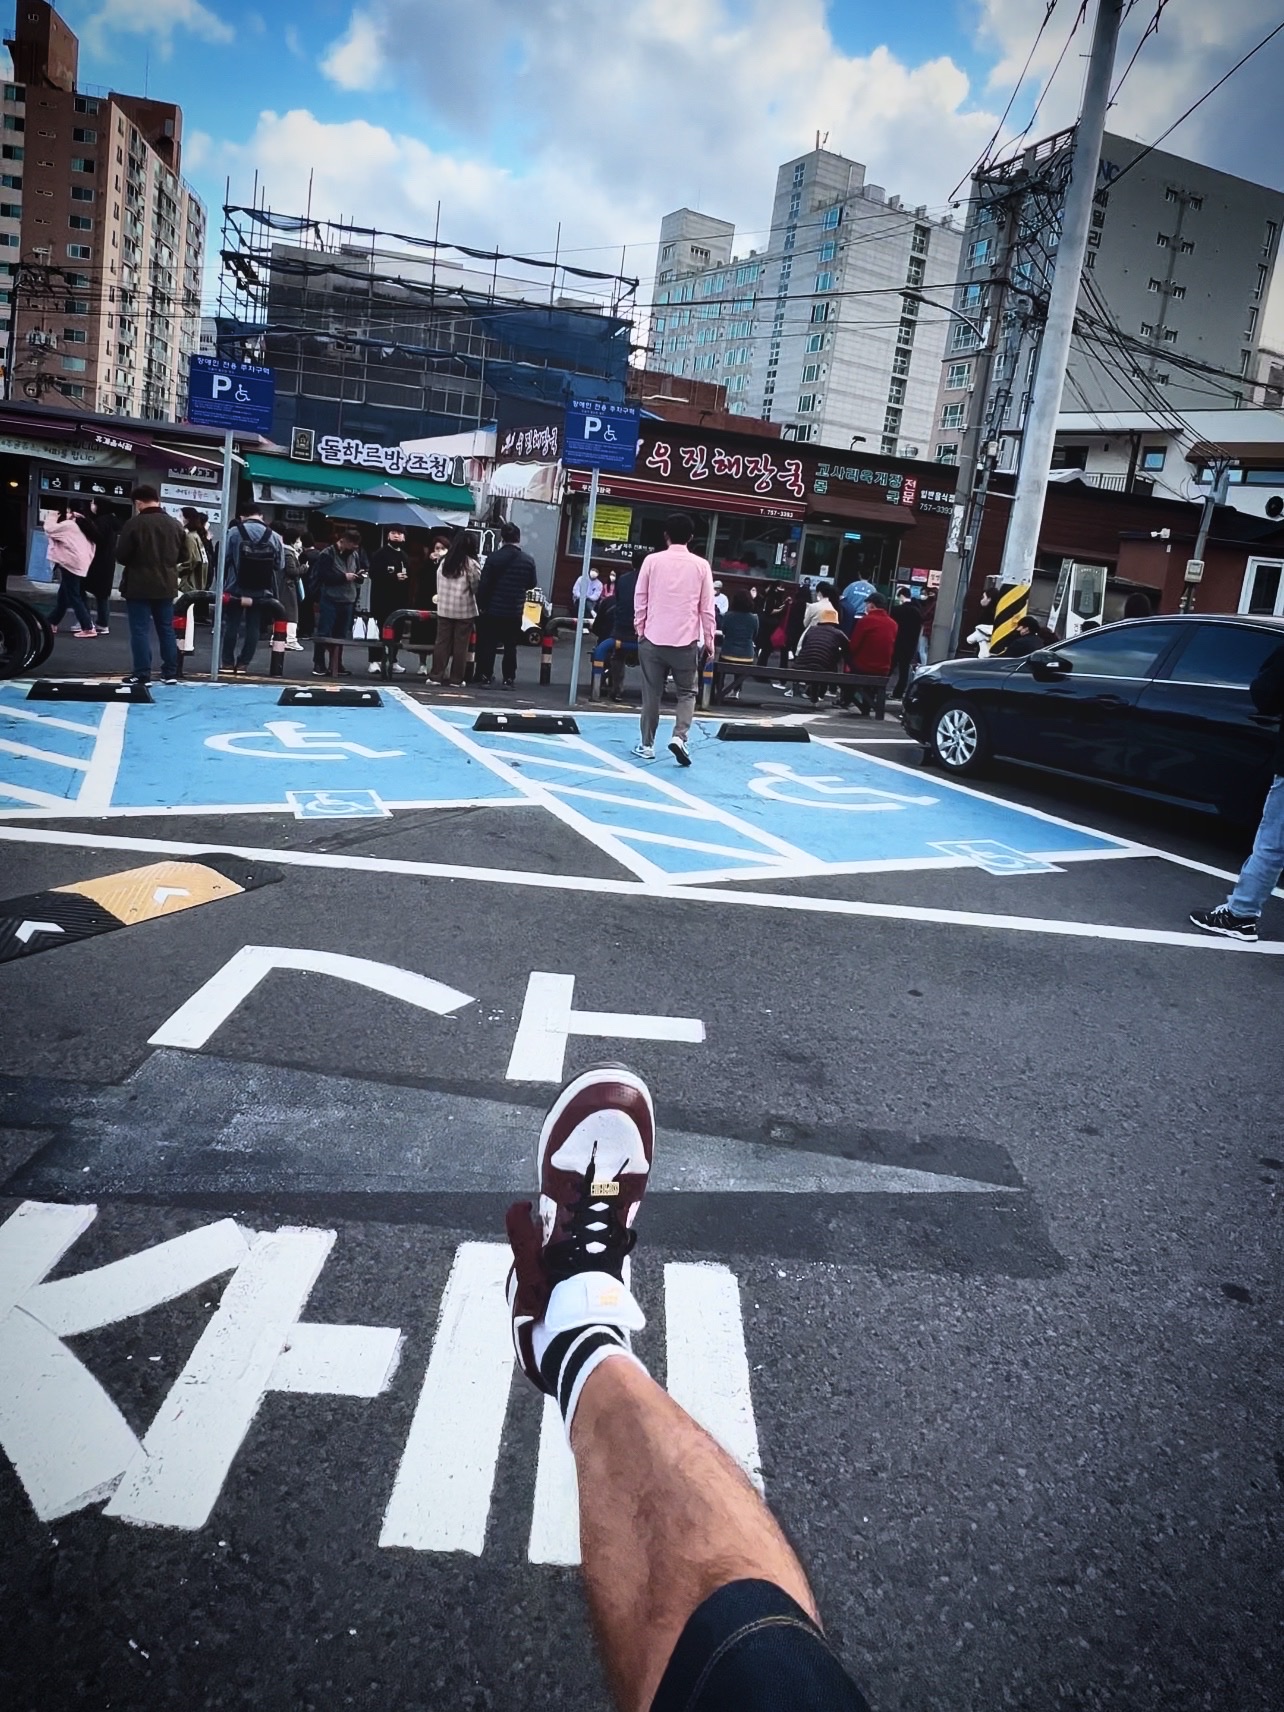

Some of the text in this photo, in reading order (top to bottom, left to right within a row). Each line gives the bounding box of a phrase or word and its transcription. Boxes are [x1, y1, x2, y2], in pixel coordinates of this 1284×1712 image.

[197, 357, 219, 367] 장애인
[223, 361, 237, 370] 전용
[240, 364, 270, 375] 주차구역
[212, 374, 232, 399] P
[572, 400, 592, 410] 장애인
[594, 402, 607, 412] 전용
[609, 404, 636, 416] 주차구역
[584, 416, 602, 440] P
[318, 435, 450, 482] 돌하르방 조청
[646, 441, 805, 498] 우진해장국
[815, 462, 918, 504] 고사리육개장 전문
